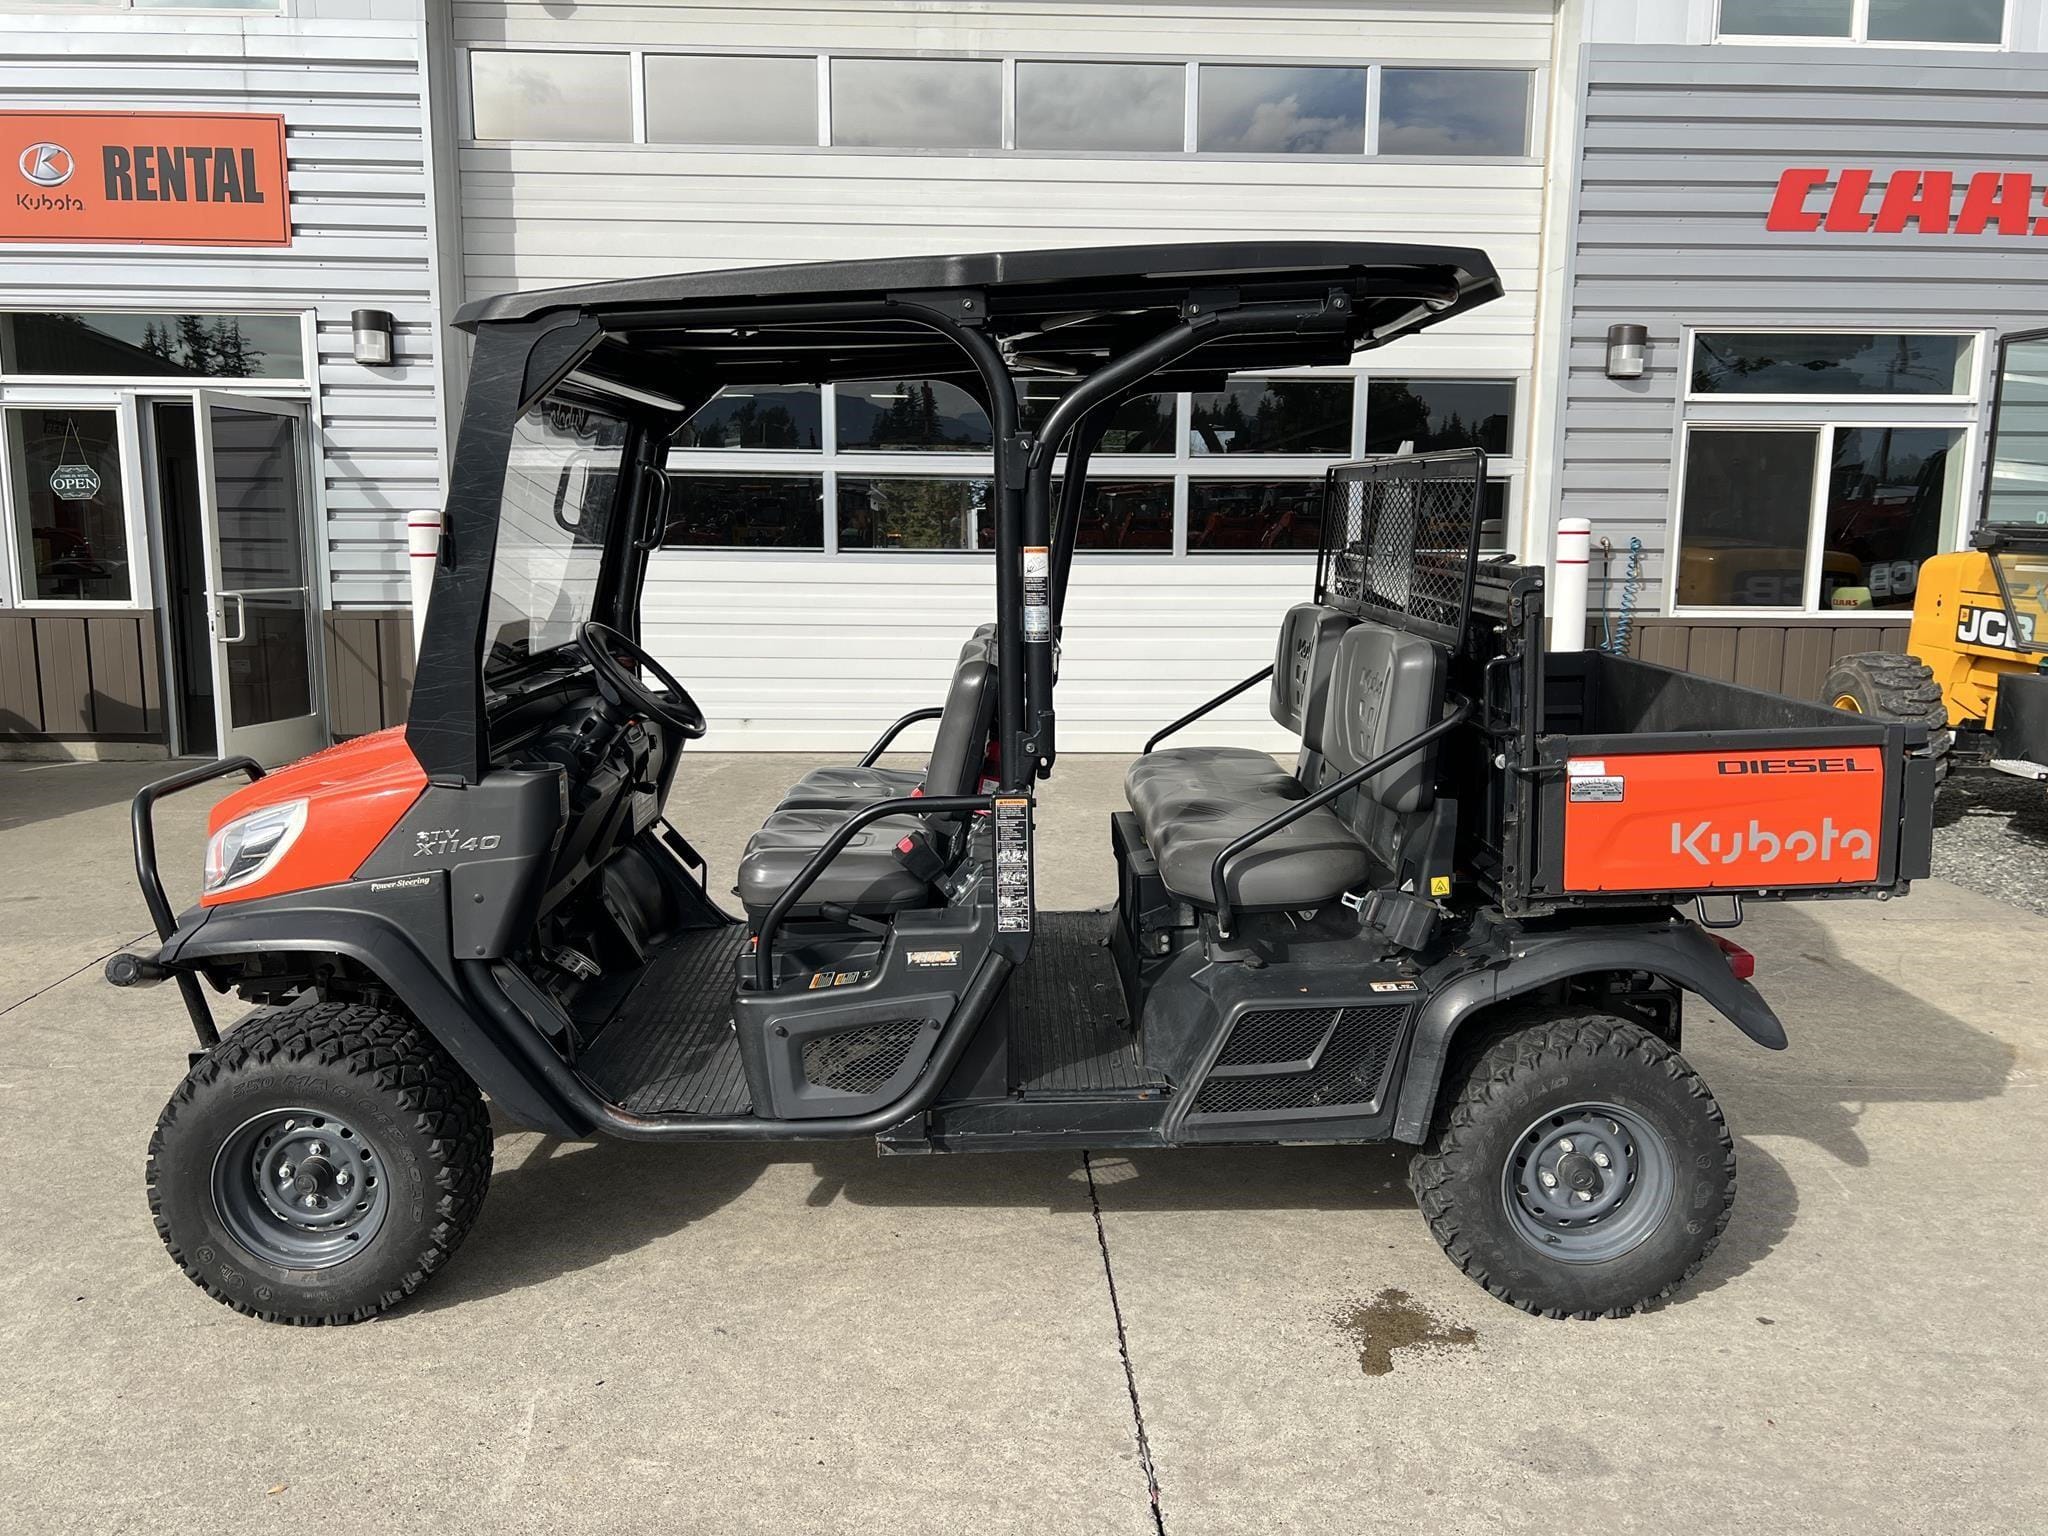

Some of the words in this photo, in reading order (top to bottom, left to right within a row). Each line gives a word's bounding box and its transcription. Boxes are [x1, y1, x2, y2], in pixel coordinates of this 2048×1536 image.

[102, 145, 265, 204] RENTAL
[16, 193, 84, 211] Kubota
[1765, 168, 2048, 237] CLAA
[52, 478, 98, 490] OPEN
[1957, 609, 2034, 649] JCB
[1718, 758, 1875, 775] DIESEL
[413, 835, 502, 857] X1140
[1671, 817, 1873, 865] Kubota
[371, 882, 396, 892] Power
[396, 877, 431, 888] Steering
